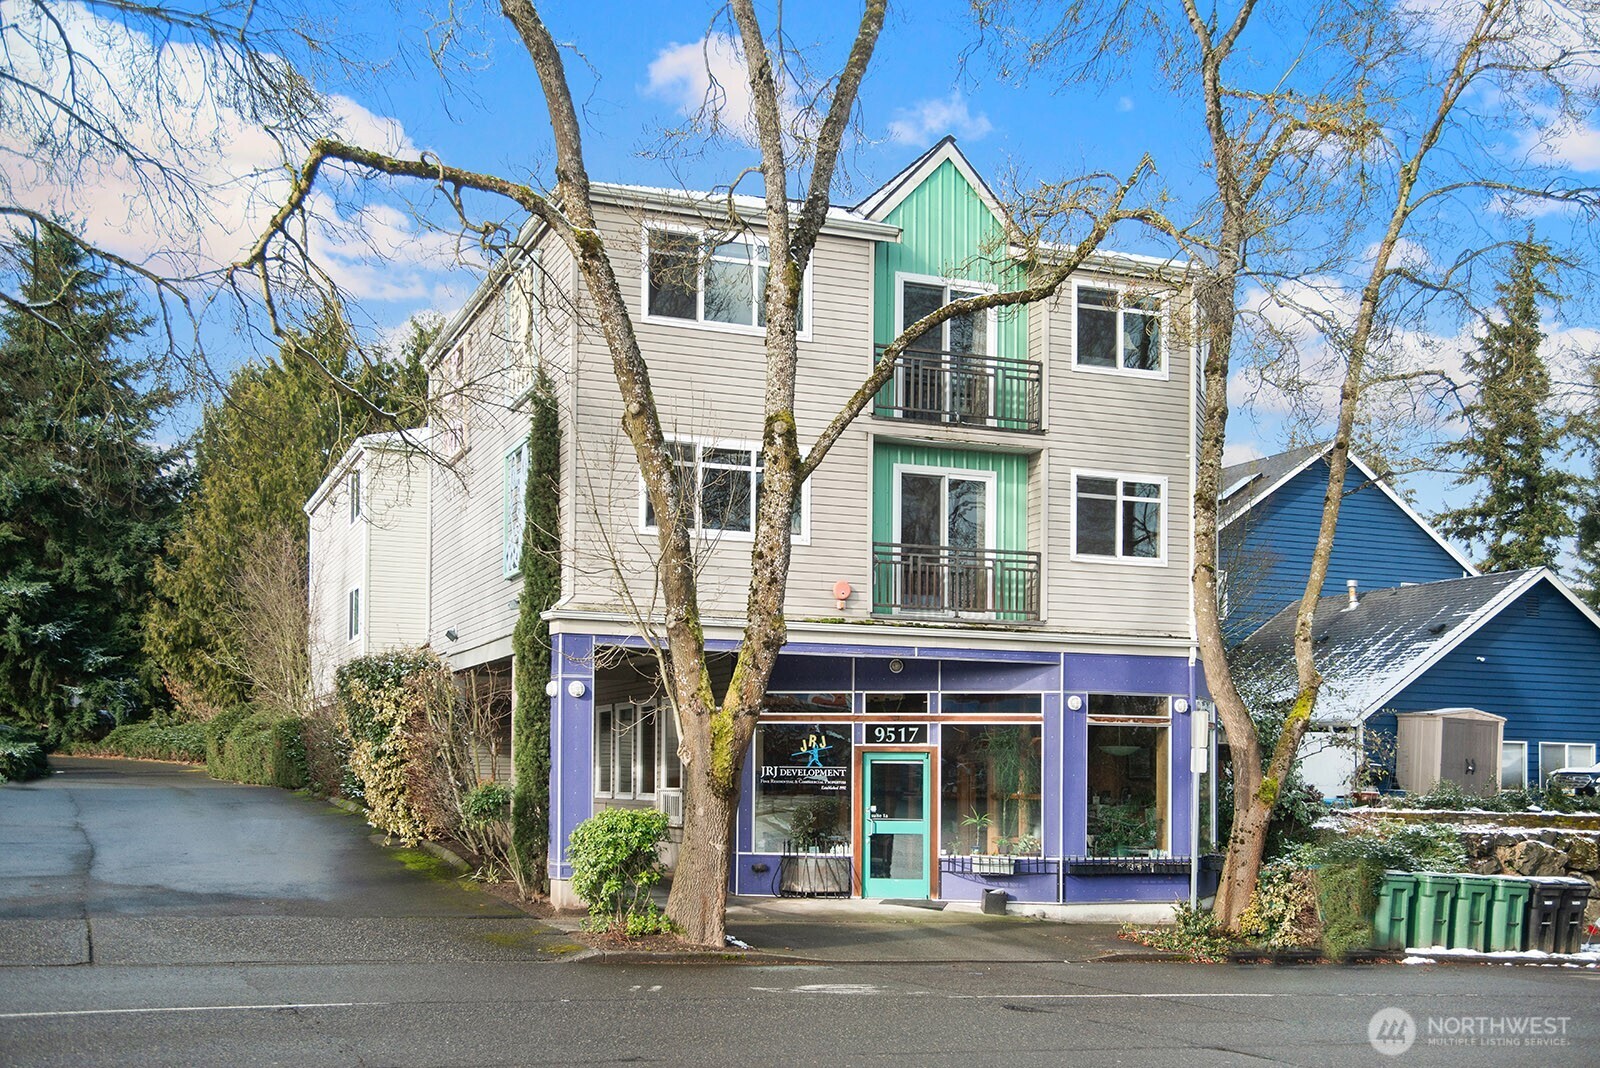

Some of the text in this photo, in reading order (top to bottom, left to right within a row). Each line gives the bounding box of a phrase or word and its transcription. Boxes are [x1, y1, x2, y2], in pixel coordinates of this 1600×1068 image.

[874, 727, 919, 742] 9517
[800, 734, 827, 752] JRJ
[760, 765, 846, 778] JRJ DEVELOPMENT
